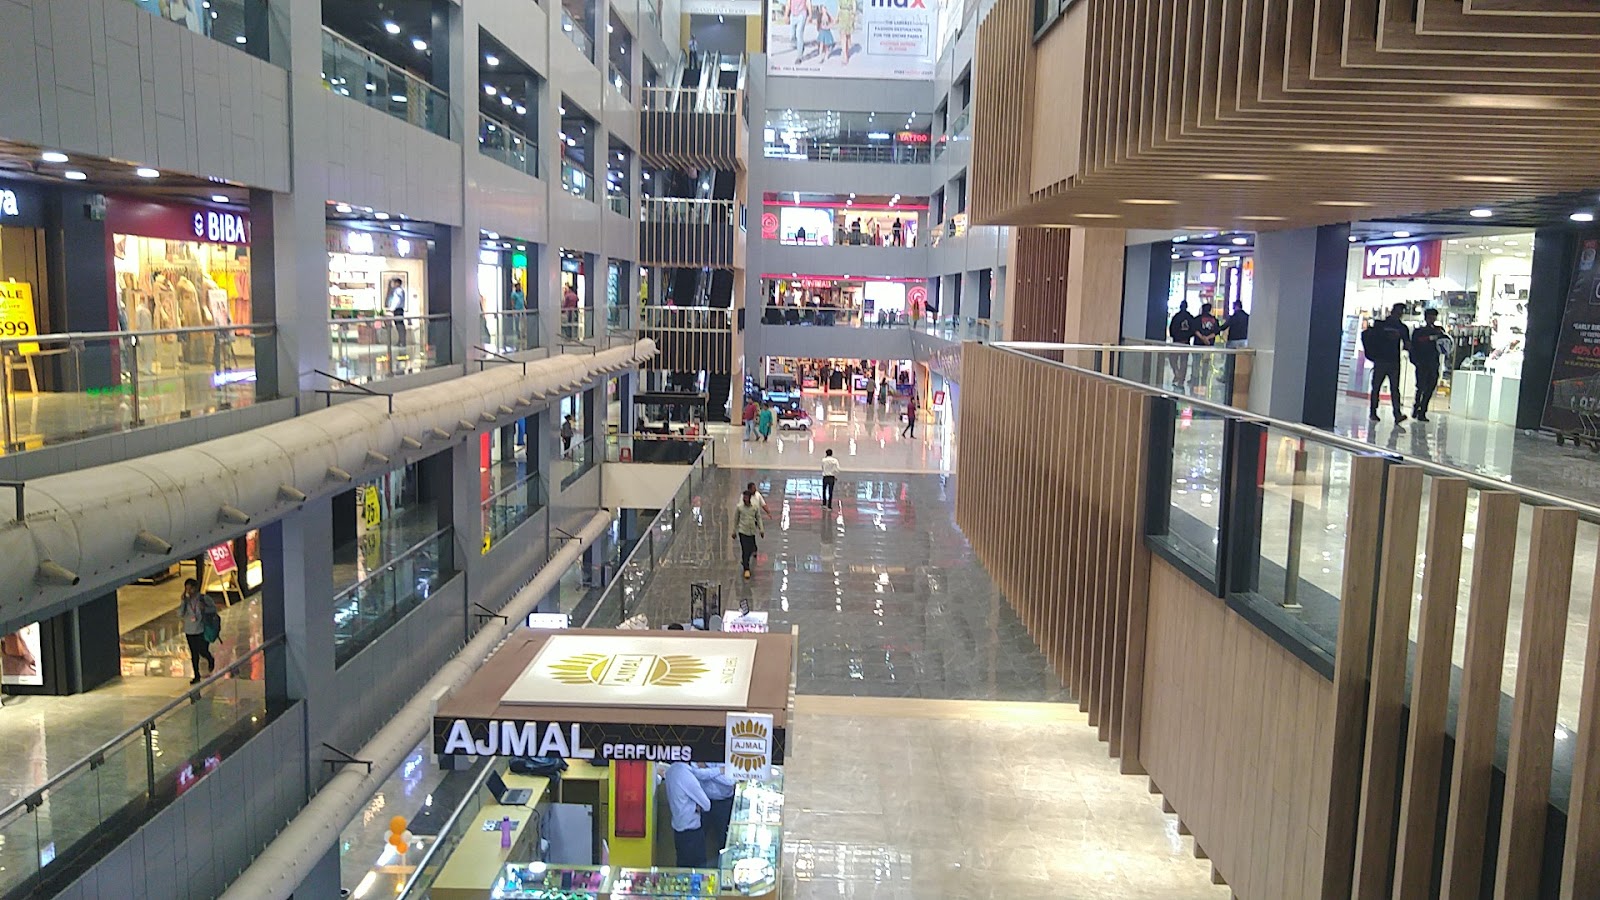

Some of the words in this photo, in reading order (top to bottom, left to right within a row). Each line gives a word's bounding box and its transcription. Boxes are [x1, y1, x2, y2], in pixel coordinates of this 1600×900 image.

[207, 211, 247, 243] BIBA
[1366, 244, 1420, 276] METRO
[444, 719, 595, 759] AJMAL
[603, 743, 692, 761] PERFUMES
[734, 741, 764, 750] AJMAL
[733, 772, 749, 780] SINCE
